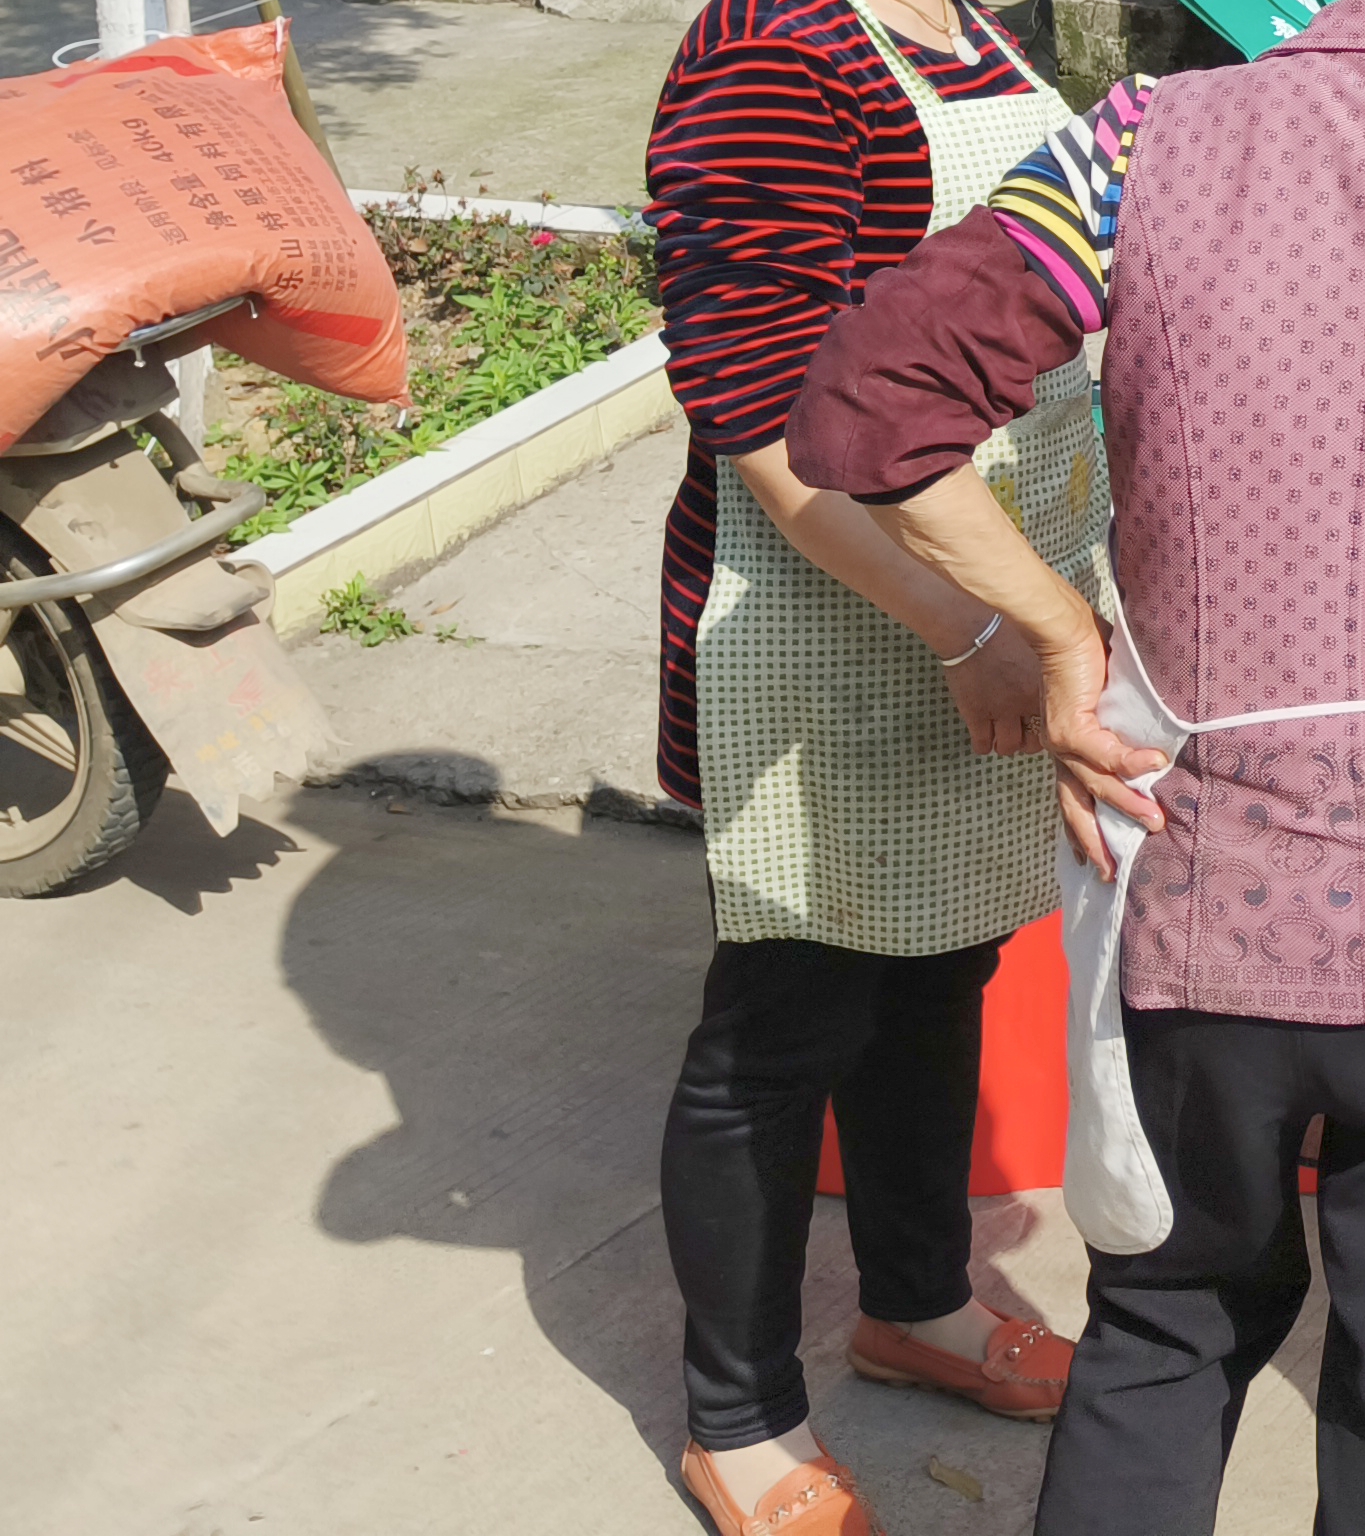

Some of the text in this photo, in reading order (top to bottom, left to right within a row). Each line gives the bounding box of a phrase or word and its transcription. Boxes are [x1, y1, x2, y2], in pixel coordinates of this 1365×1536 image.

[10, 158, 119, 247] 小猪料
[114, 77, 304, 291] 乐山特驱饲料有限公
